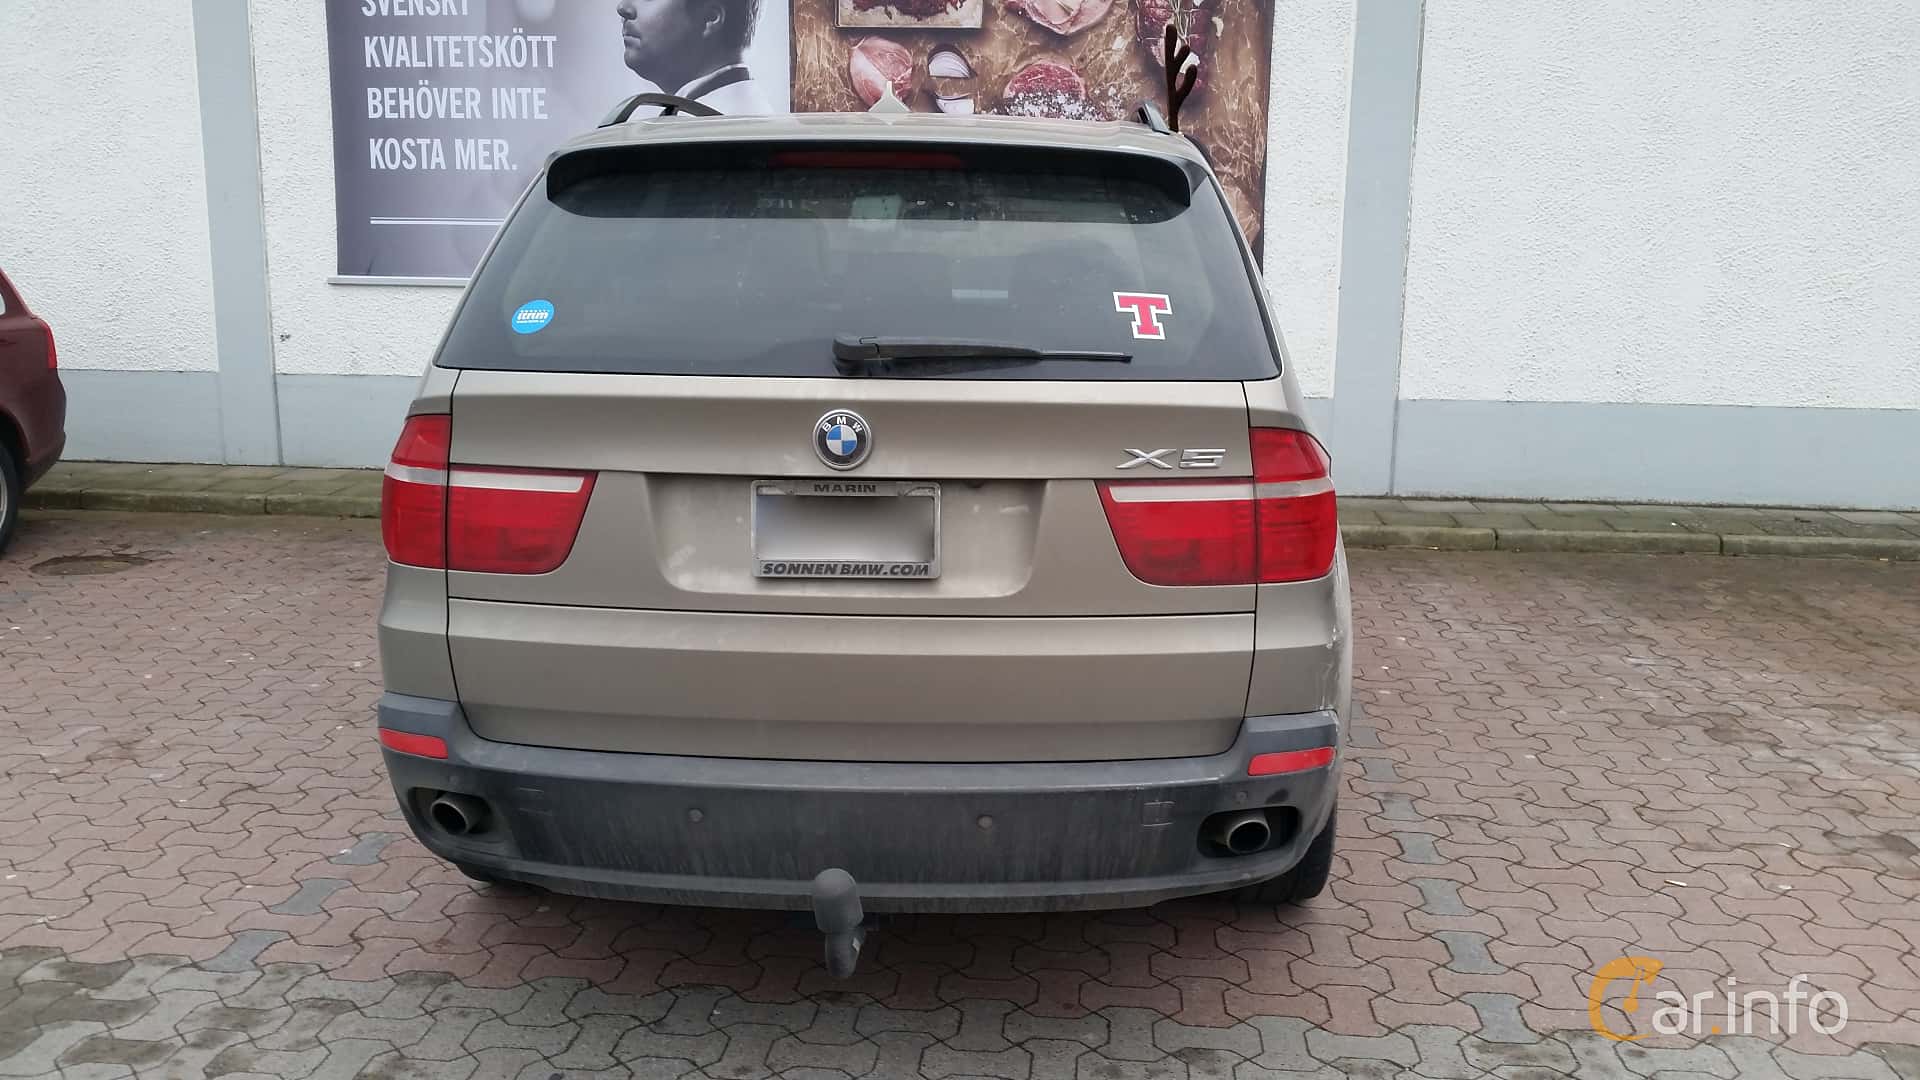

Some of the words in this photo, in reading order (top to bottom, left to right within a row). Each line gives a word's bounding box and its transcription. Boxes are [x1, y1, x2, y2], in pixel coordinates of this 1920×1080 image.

[364, 28, 557, 68] KVALITETSKÖTT
[367, 80, 481, 119] BEHÖVER
[492, 87, 548, 120] INTE
[369, 138, 446, 170] KOSTA
[455, 138, 517, 170] MER.
[1112, 291, 1173, 340] T
[822, 416, 862, 432] BMW
[1115, 448, 1226, 470] X5
[813, 484, 876, 493] MARIN
